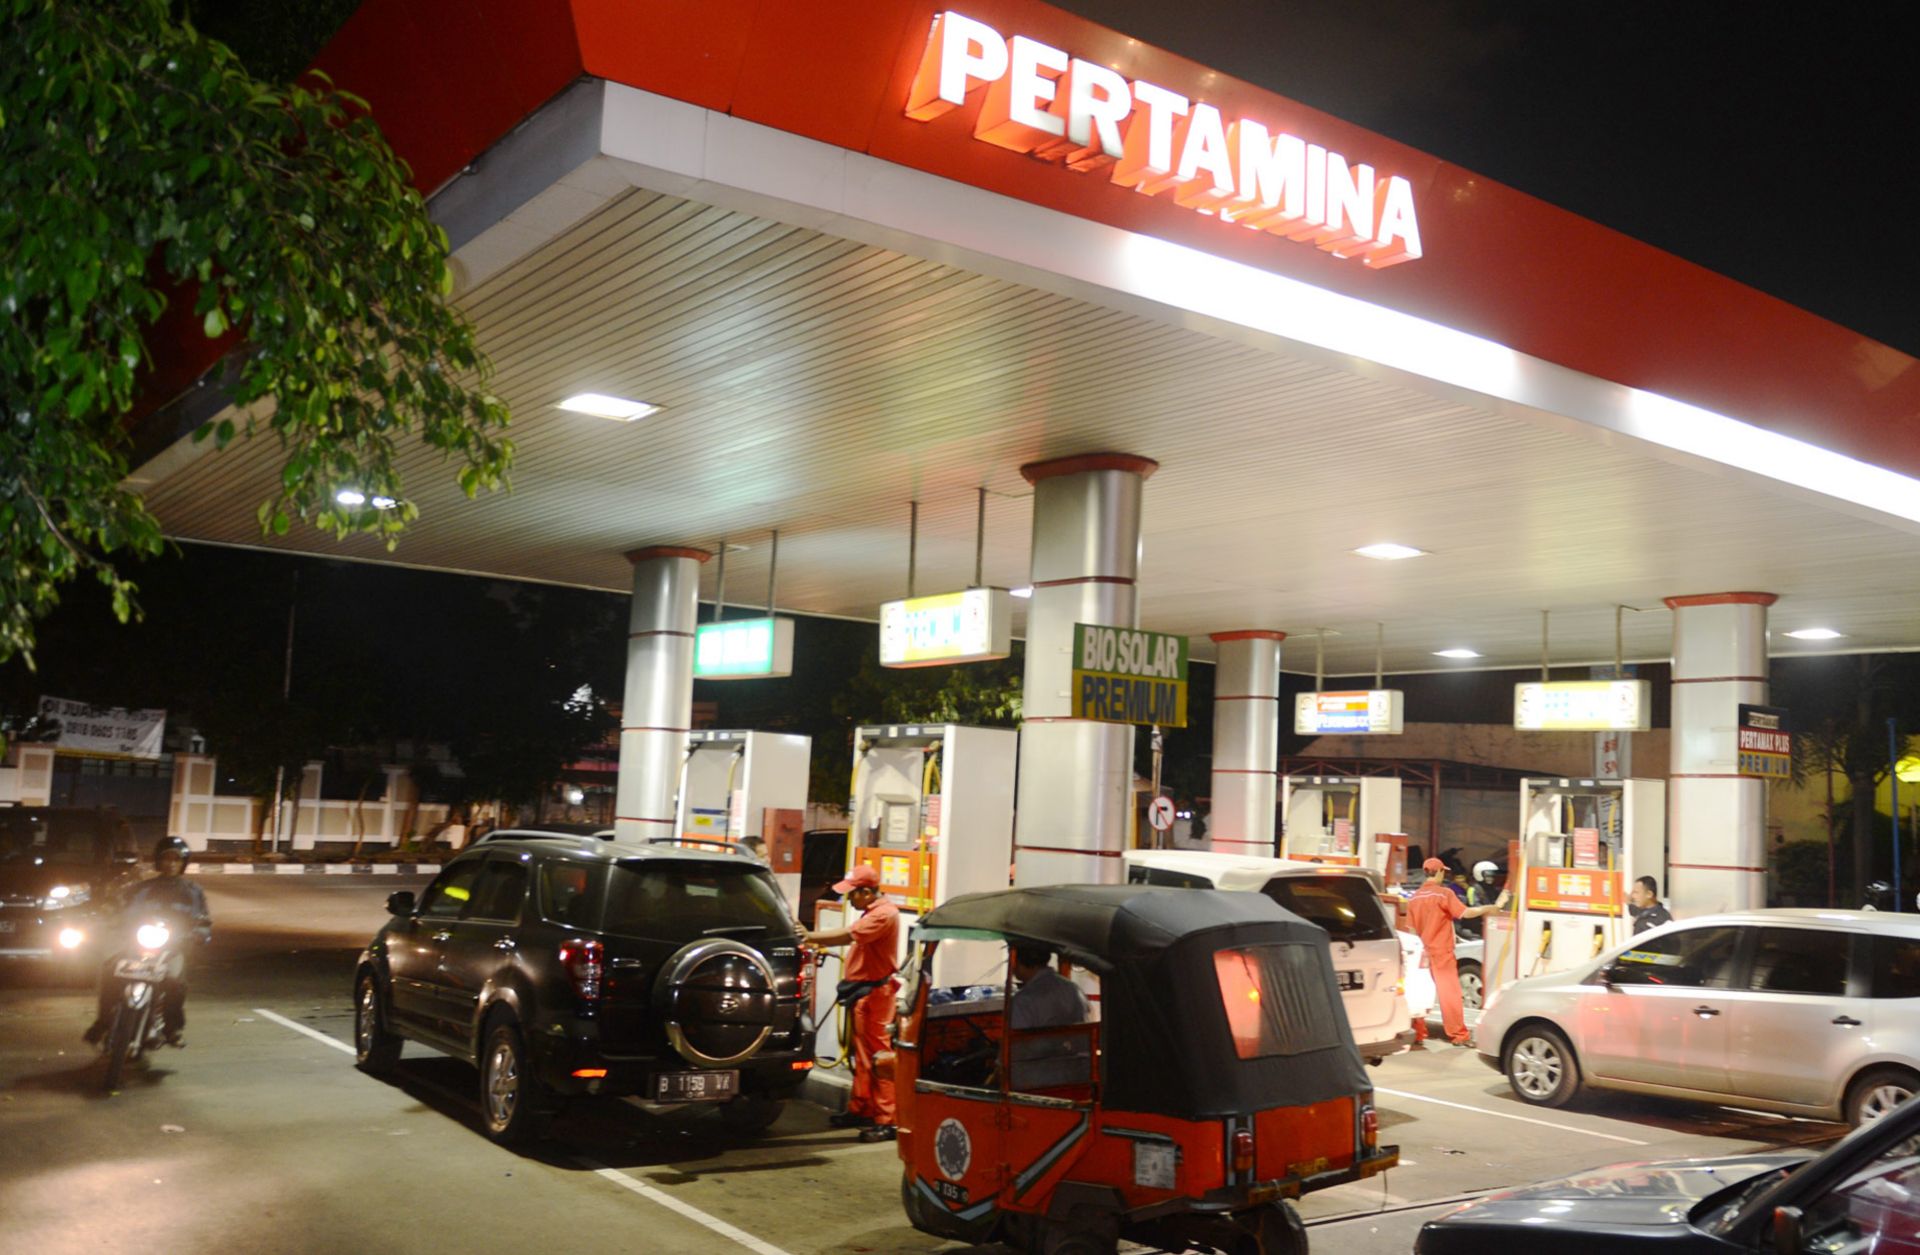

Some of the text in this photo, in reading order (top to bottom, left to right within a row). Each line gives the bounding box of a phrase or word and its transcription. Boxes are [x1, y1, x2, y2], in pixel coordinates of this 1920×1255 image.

[937, 10, 1423, 259] PERTAMINA
[1081, 674, 1178, 724] PREMIUM
[1740, 730, 1790, 753] PERTAMAX PLUS
[660, 1077, 669, 1093] B
